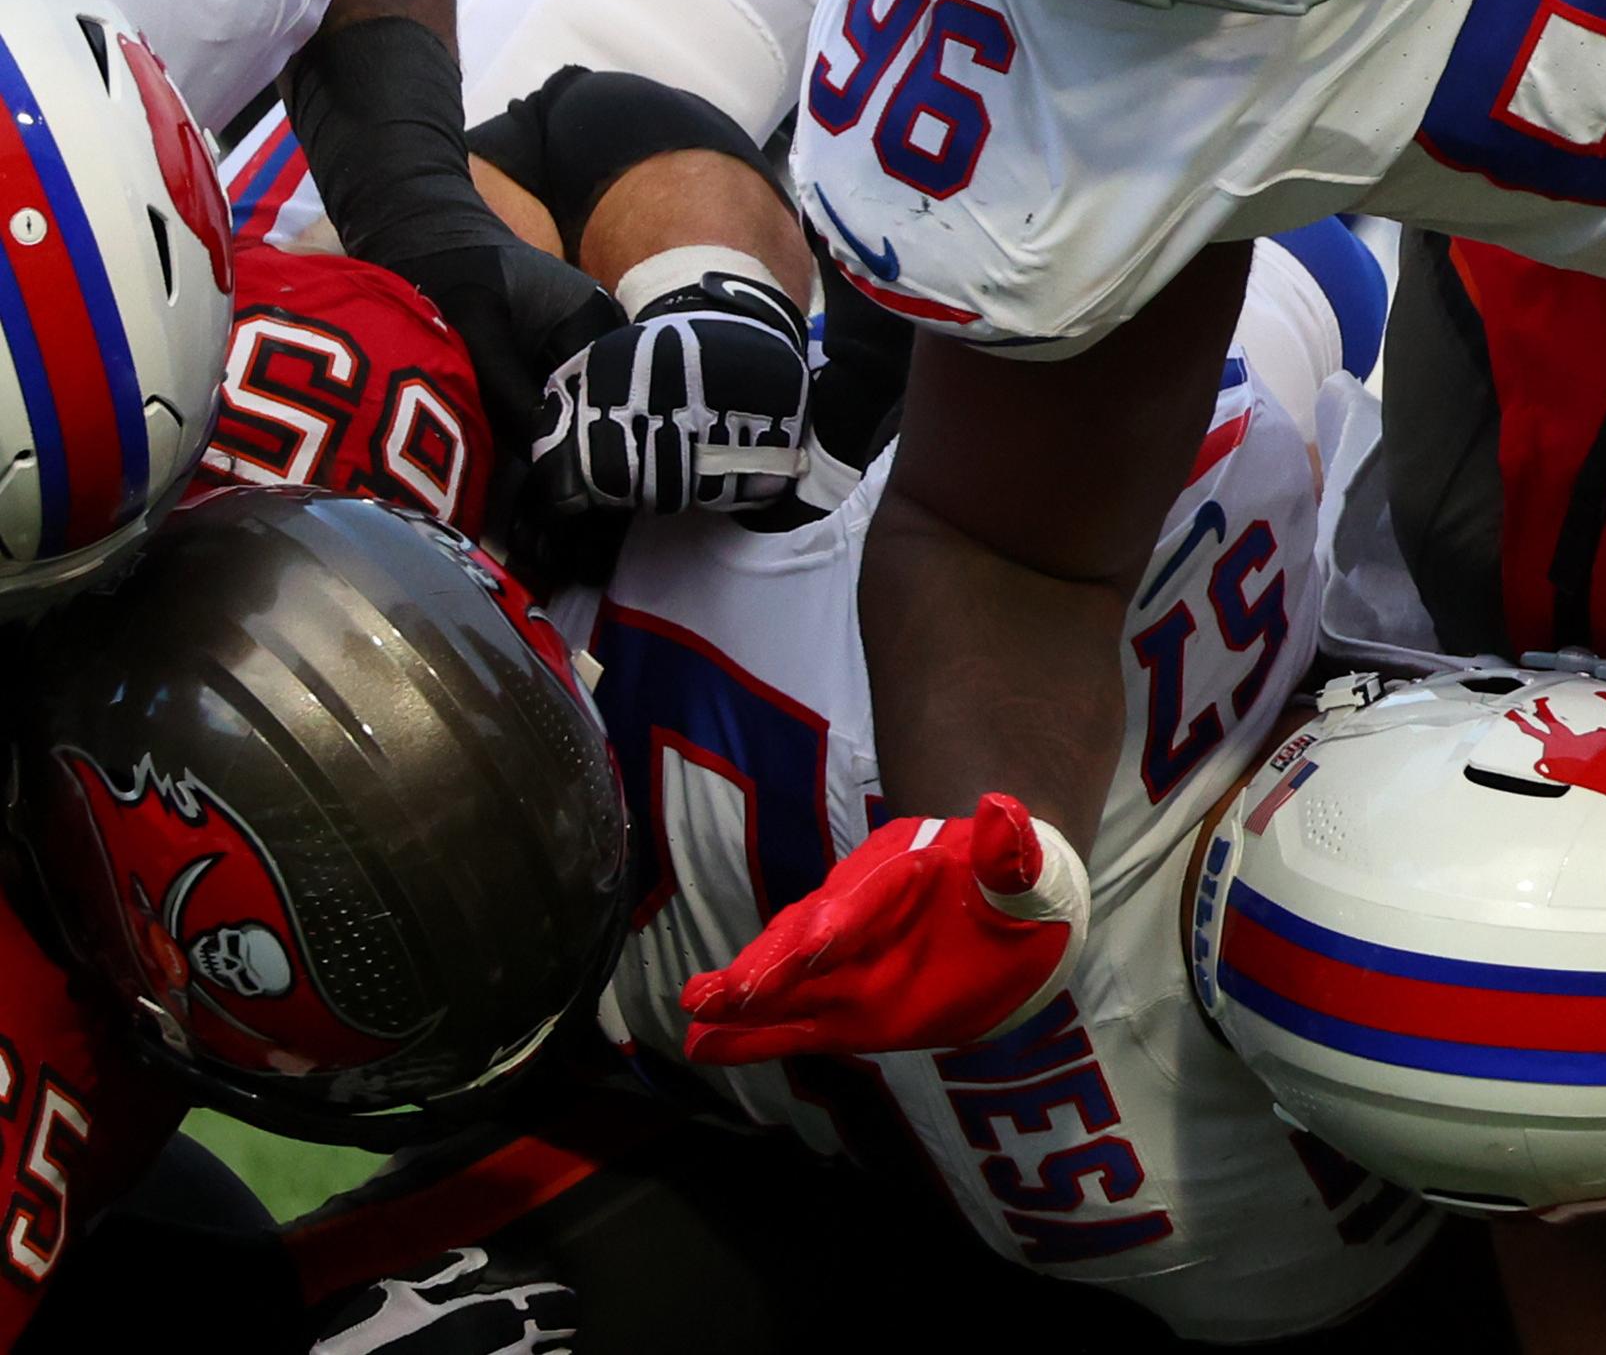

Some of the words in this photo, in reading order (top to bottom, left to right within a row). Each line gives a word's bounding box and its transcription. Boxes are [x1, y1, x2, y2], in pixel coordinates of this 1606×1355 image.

[1130, 519, 1290, 804] 57
[0, 1036, 94, 1286] 5
[931, 988, 1175, 1264] NESA
